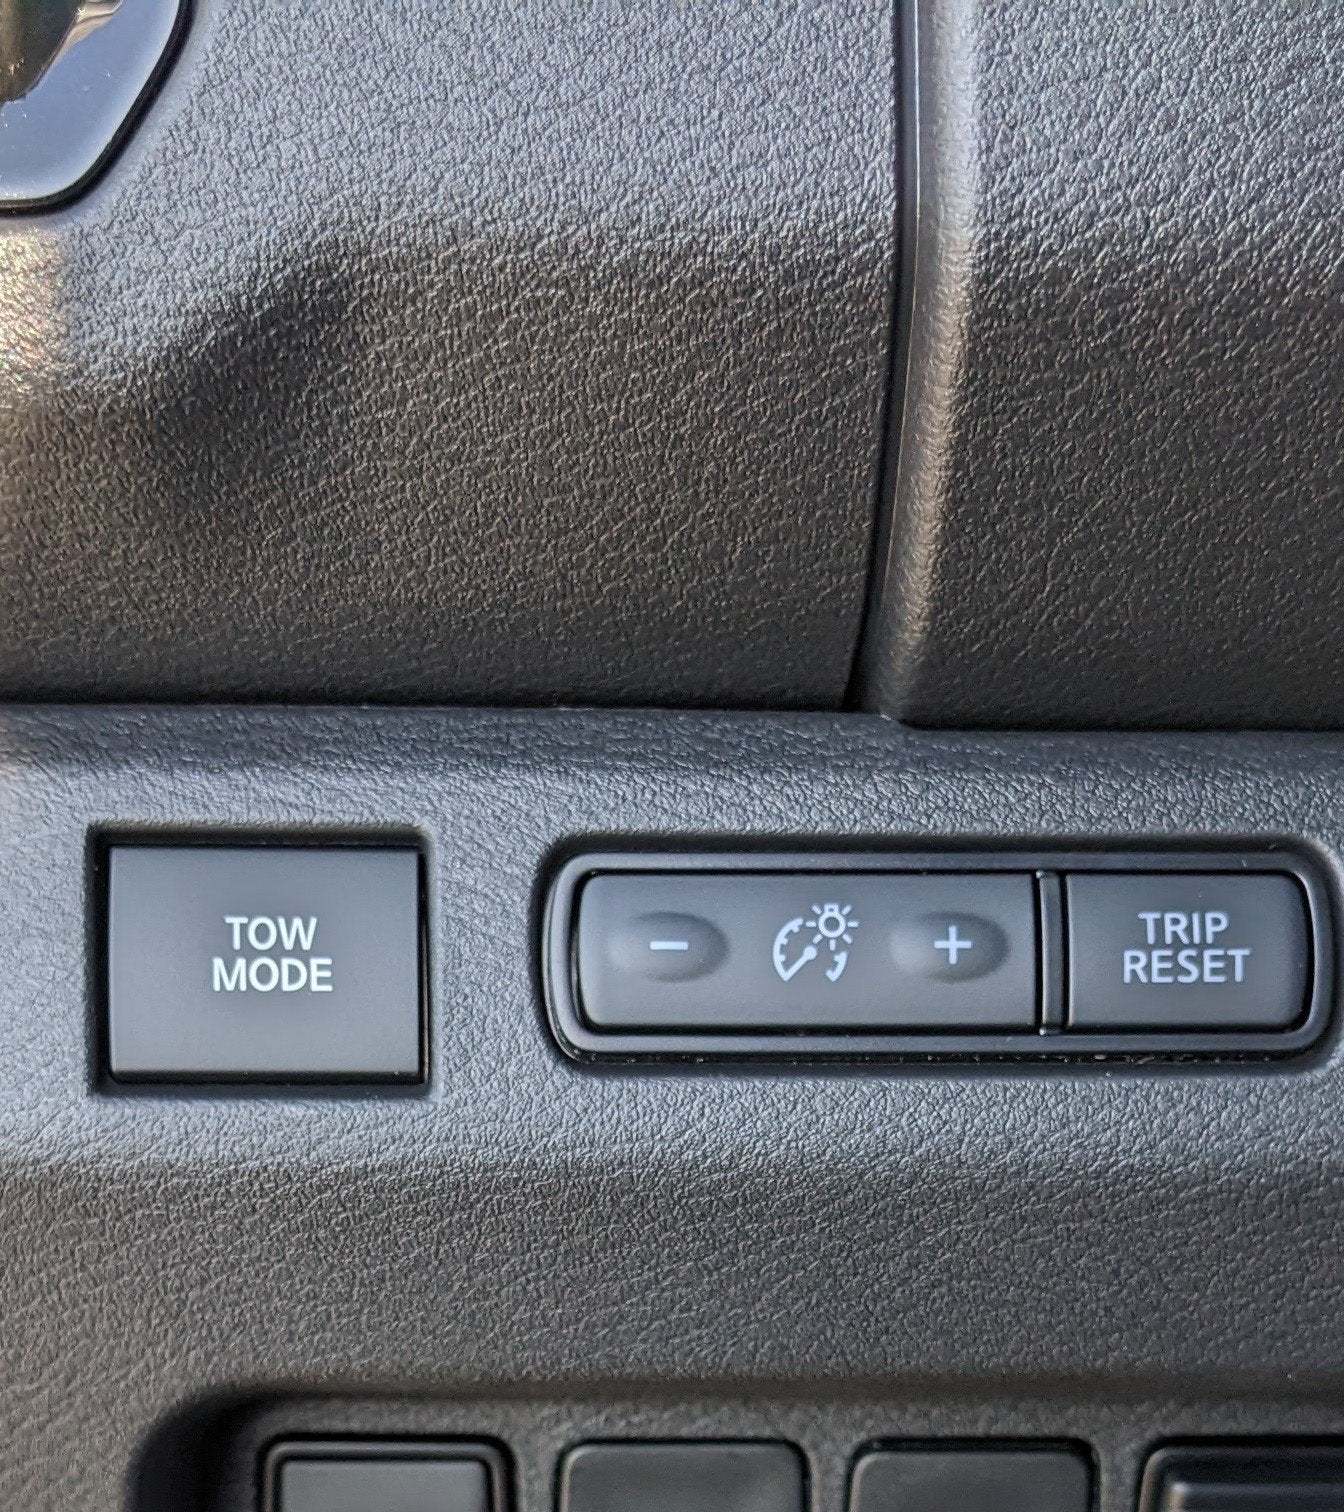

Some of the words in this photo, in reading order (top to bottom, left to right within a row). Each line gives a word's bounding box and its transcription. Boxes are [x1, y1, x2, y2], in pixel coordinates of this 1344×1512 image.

[224, 915, 318, 951] TOW
[1137, 911, 1229, 945] TRIP
[212, 956, 334, 992] MODE
[1122, 948, 1251, 984] RESET
